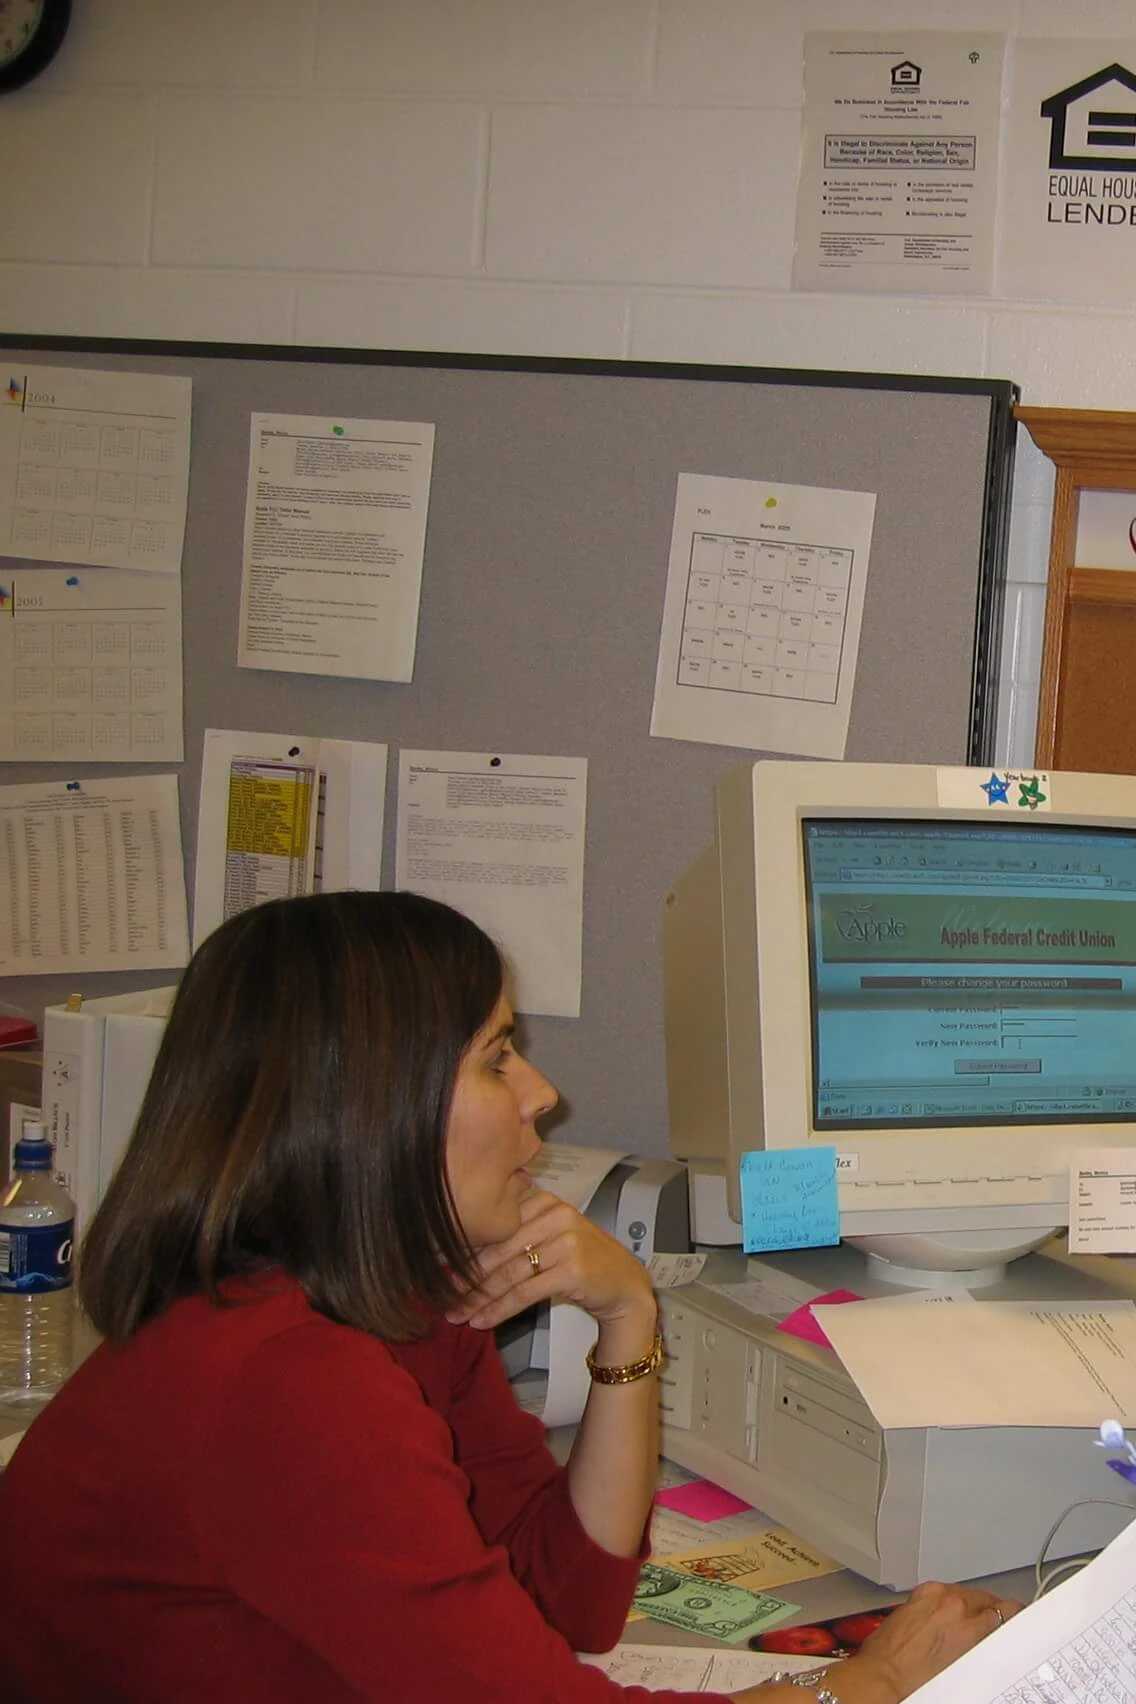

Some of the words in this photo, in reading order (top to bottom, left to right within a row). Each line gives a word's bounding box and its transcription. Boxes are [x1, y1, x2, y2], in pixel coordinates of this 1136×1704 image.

[841, 140, 860, 148] Illegal
[869, 140, 909, 148] Discriminate
[910, 141, 935, 149] Against
[936, 141, 948, 149] Any
[949, 158, 969, 166] Origin
[1048, 175, 1097, 198] EQUAL
[29, 393, 56, 404] 2004
[847, 916, 906, 943] Apple
[941, 926, 979, 949] Apple
[983, 926, 1032, 947] Federal
[1036, 928, 1077, 947] Credit
[1079, 929, 1116, 949] Union
[920, 977, 955, 987] Please
[957, 978, 994, 989] change
[996, 979, 1019, 989] your
[1020, 978, 1068, 989] password
[915, 1039, 939, 1048] Verify
